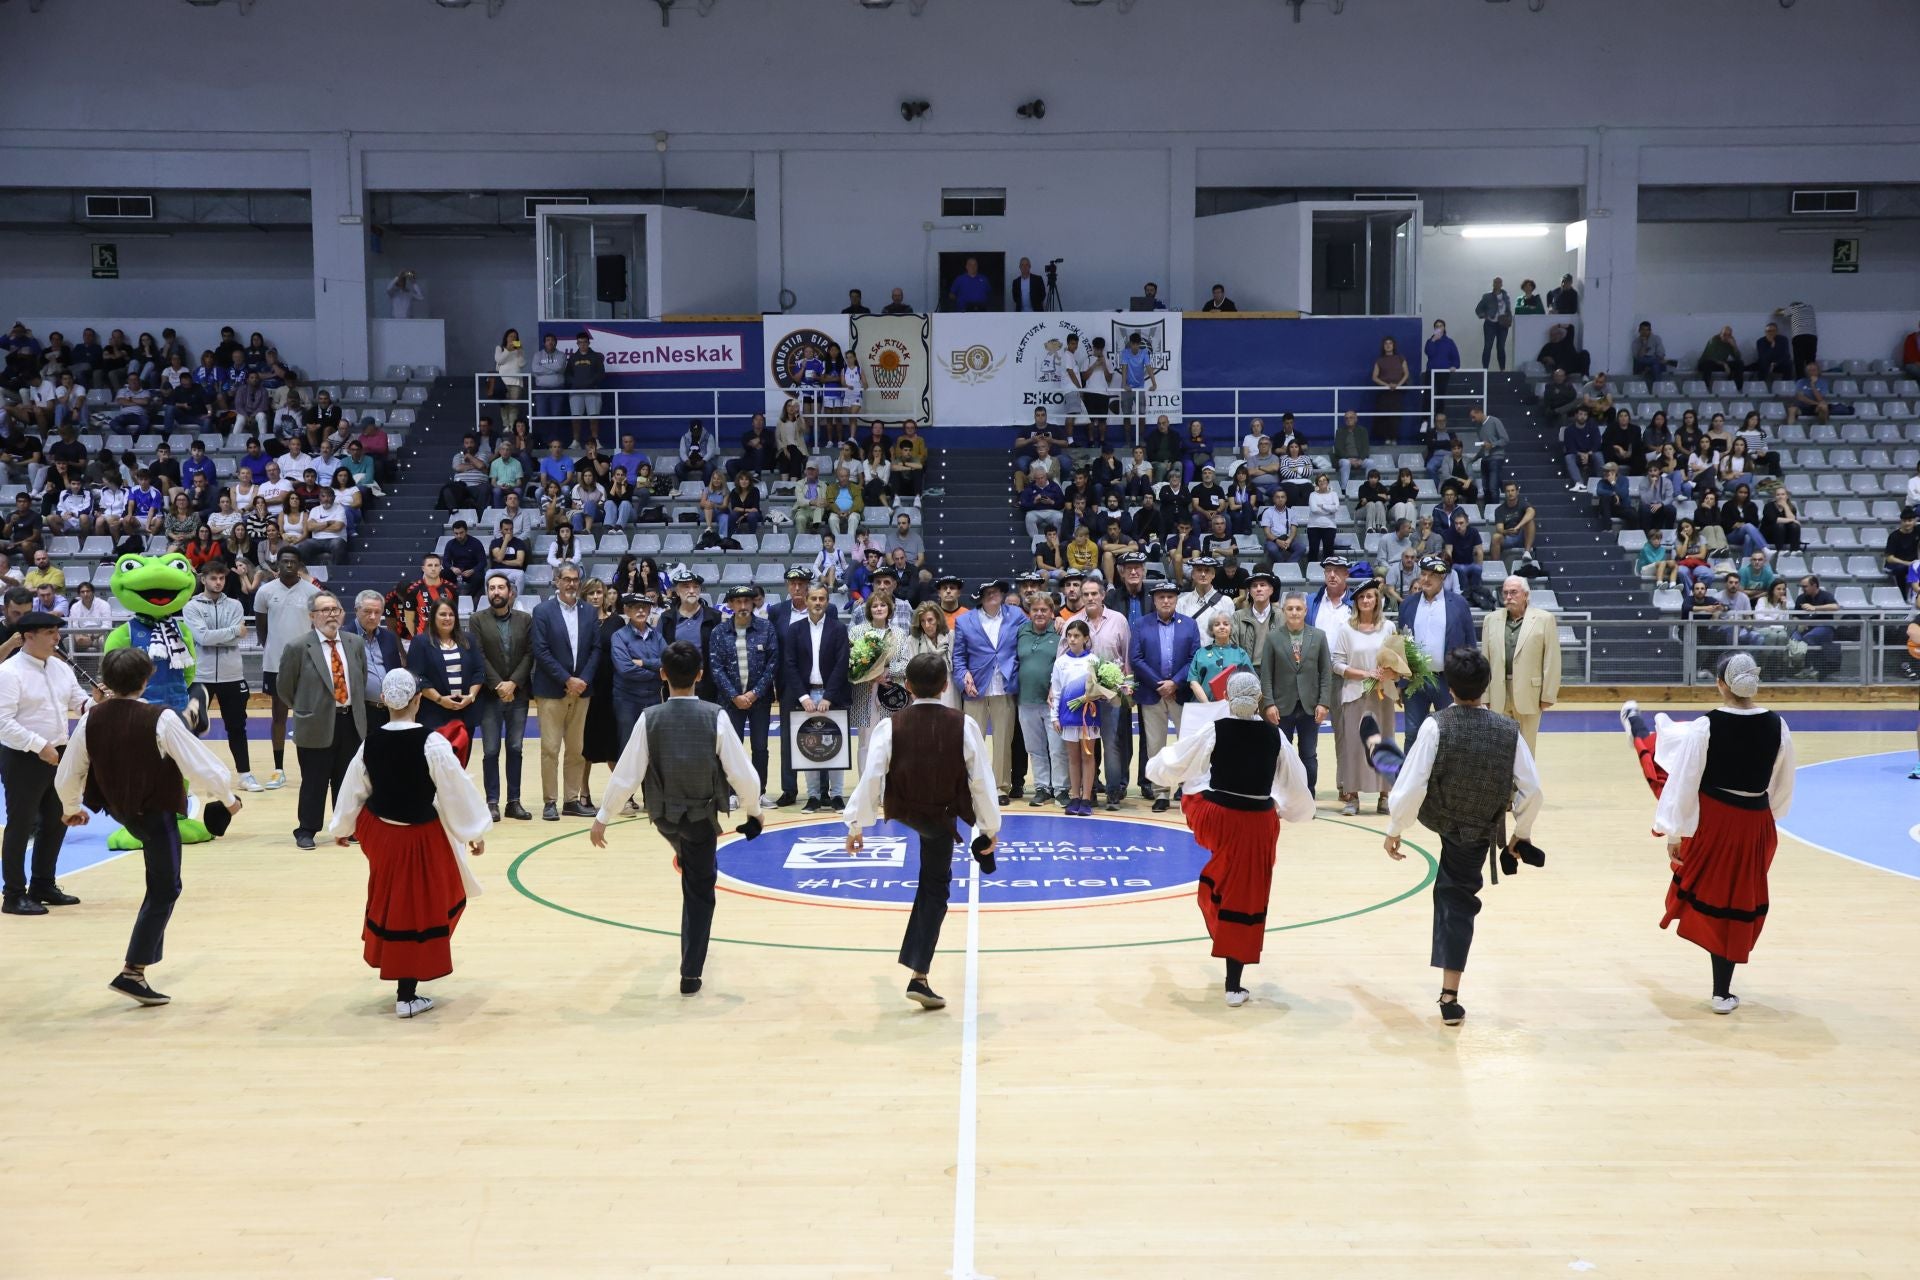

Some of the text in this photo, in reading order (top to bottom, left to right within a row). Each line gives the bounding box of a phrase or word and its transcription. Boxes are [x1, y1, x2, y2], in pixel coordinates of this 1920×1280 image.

[564, 345, 734, 365] #azenNeskak
[775, 334, 803, 380] DONOSTIA
[868, 338, 911, 361] ASKATUAK
[951, 344, 993, 374] 50
[1147, 393, 1181, 407] rne
[999, 845, 1165, 854] SEBASTIÁN
[1052, 854, 1130, 862] Kirola
[796, 877, 1153, 889] #KiroTxartela
